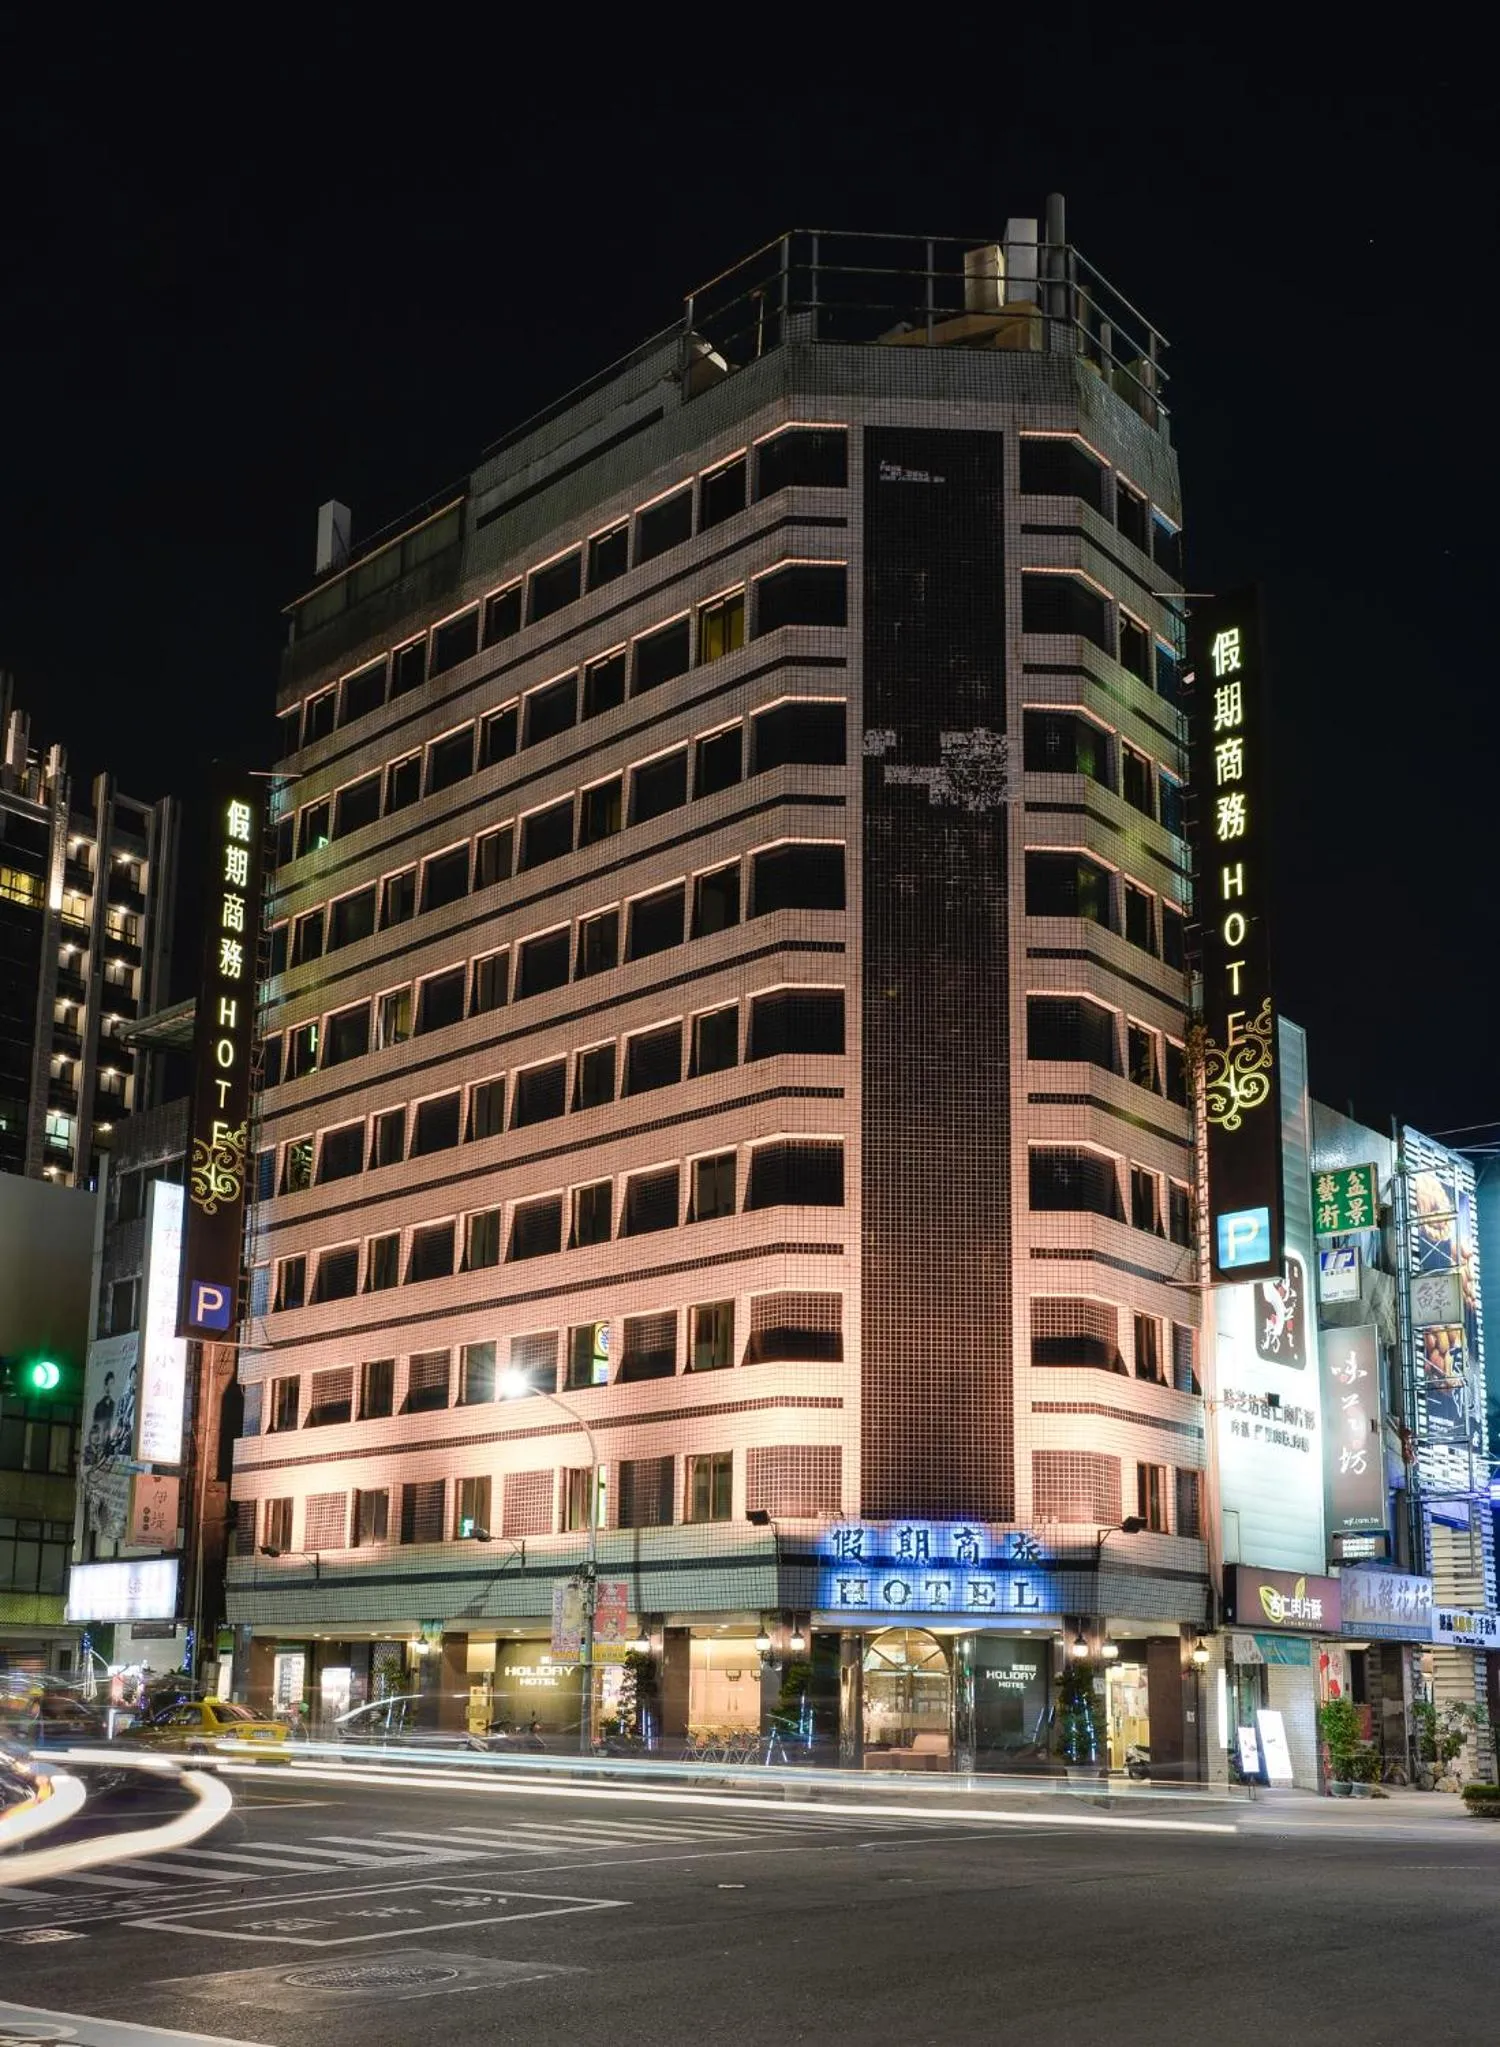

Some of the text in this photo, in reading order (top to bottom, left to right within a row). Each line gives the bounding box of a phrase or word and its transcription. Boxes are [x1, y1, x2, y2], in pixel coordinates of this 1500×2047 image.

[1212, 627, 1247, 1099] 假期商務 HOTEL
[210, 800, 251, 1192] 假期商務 HOTEL
[1316, 1174, 1341, 1229] 藝術
[1344, 1171, 1368, 1226] 盆景
[1227, 1216, 1260, 1262] P
[197, 1286, 223, 1323] P
[832, 1525, 1044, 1566] 假期商旅
[835, 1578, 1040, 1609] HOTEL
[504, 1665, 575, 1677] HOLIDAY
[519, 1677, 559, 1686] HOTEL
[986, 1669, 1037, 1681] HOLIDAY
[998, 1681, 1027, 1689] HOTEL
